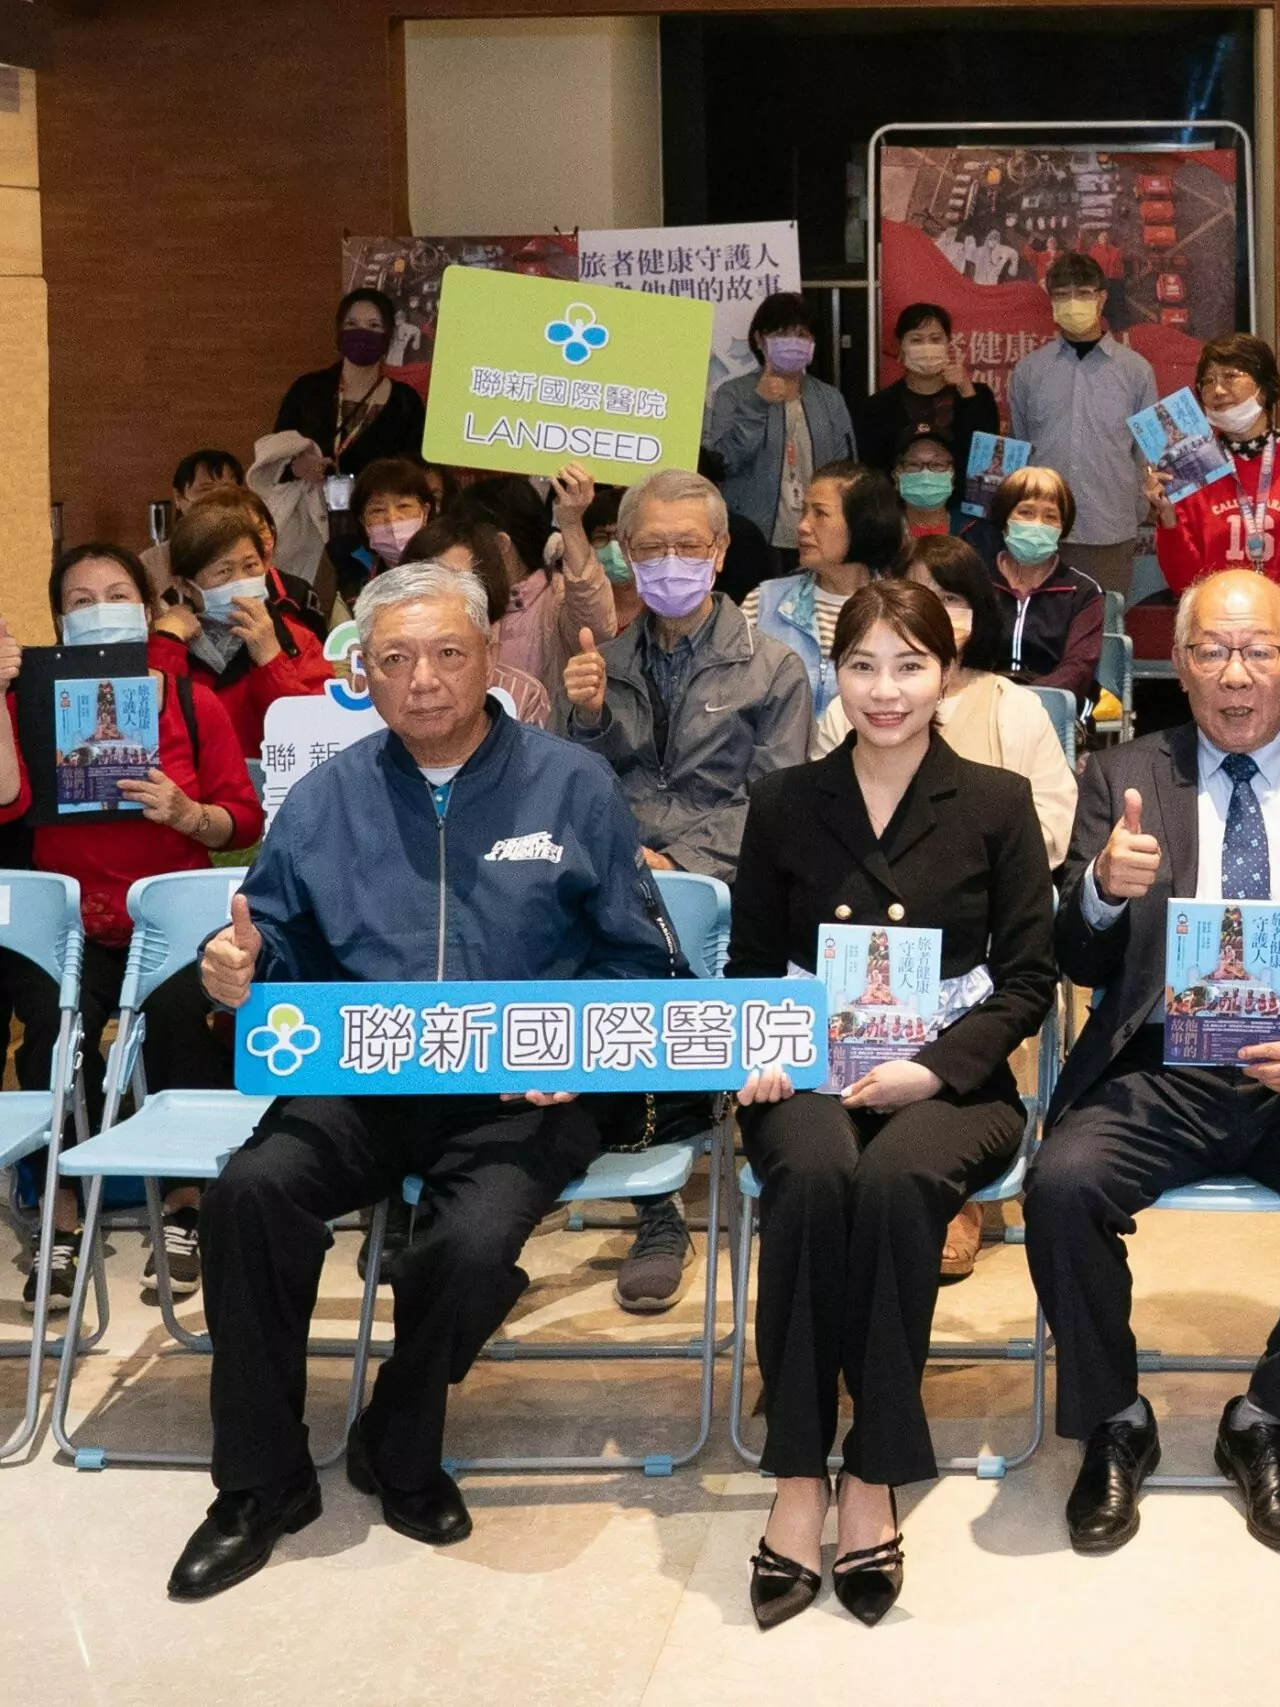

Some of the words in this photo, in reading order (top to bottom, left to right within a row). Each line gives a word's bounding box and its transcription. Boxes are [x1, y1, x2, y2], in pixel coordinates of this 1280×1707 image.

[580, 243, 779, 278] 旅者健康守護人
[470, 366, 668, 419] 聯新國際醫院
[464, 412, 662, 464] LANDSEED
[340, 999, 817, 1075] 聯新國際醫院
